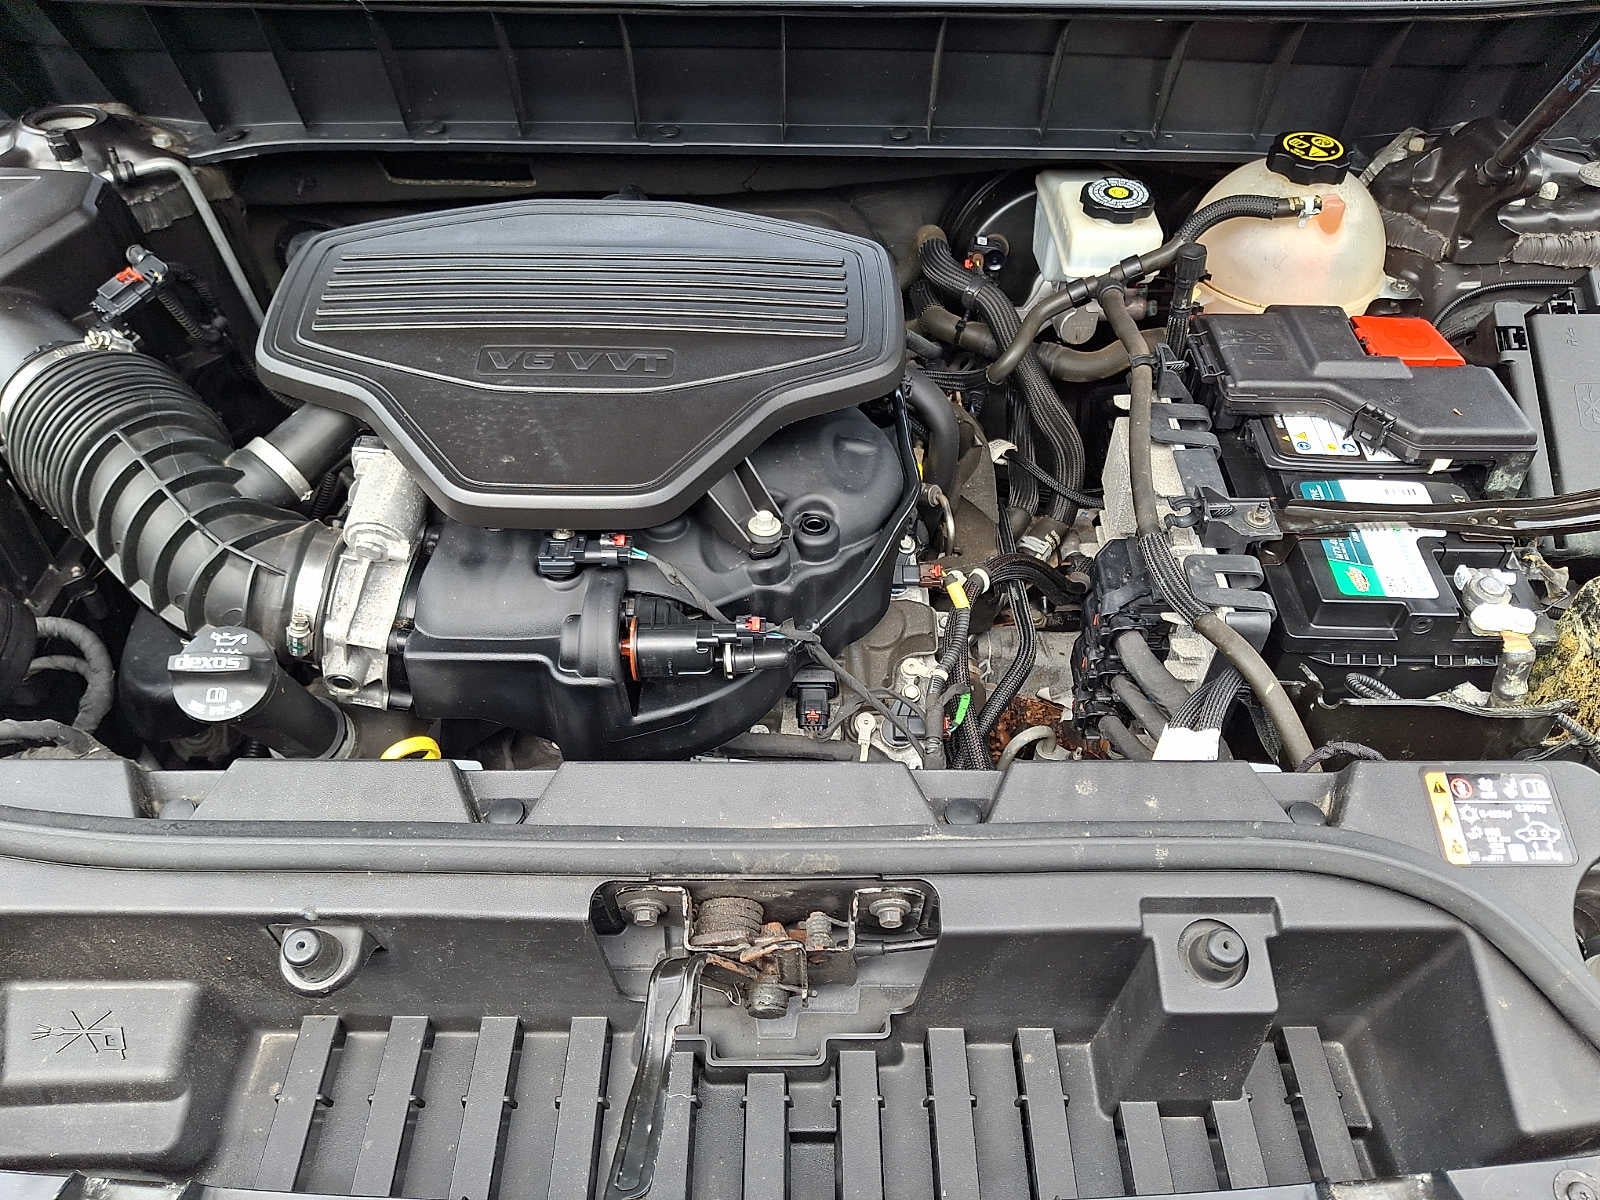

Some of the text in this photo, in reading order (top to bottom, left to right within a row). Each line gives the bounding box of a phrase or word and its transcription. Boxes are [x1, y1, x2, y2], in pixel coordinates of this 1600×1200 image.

[487, 351, 668, 372] V6 VVT
[174, 654, 243, 671] dexos
